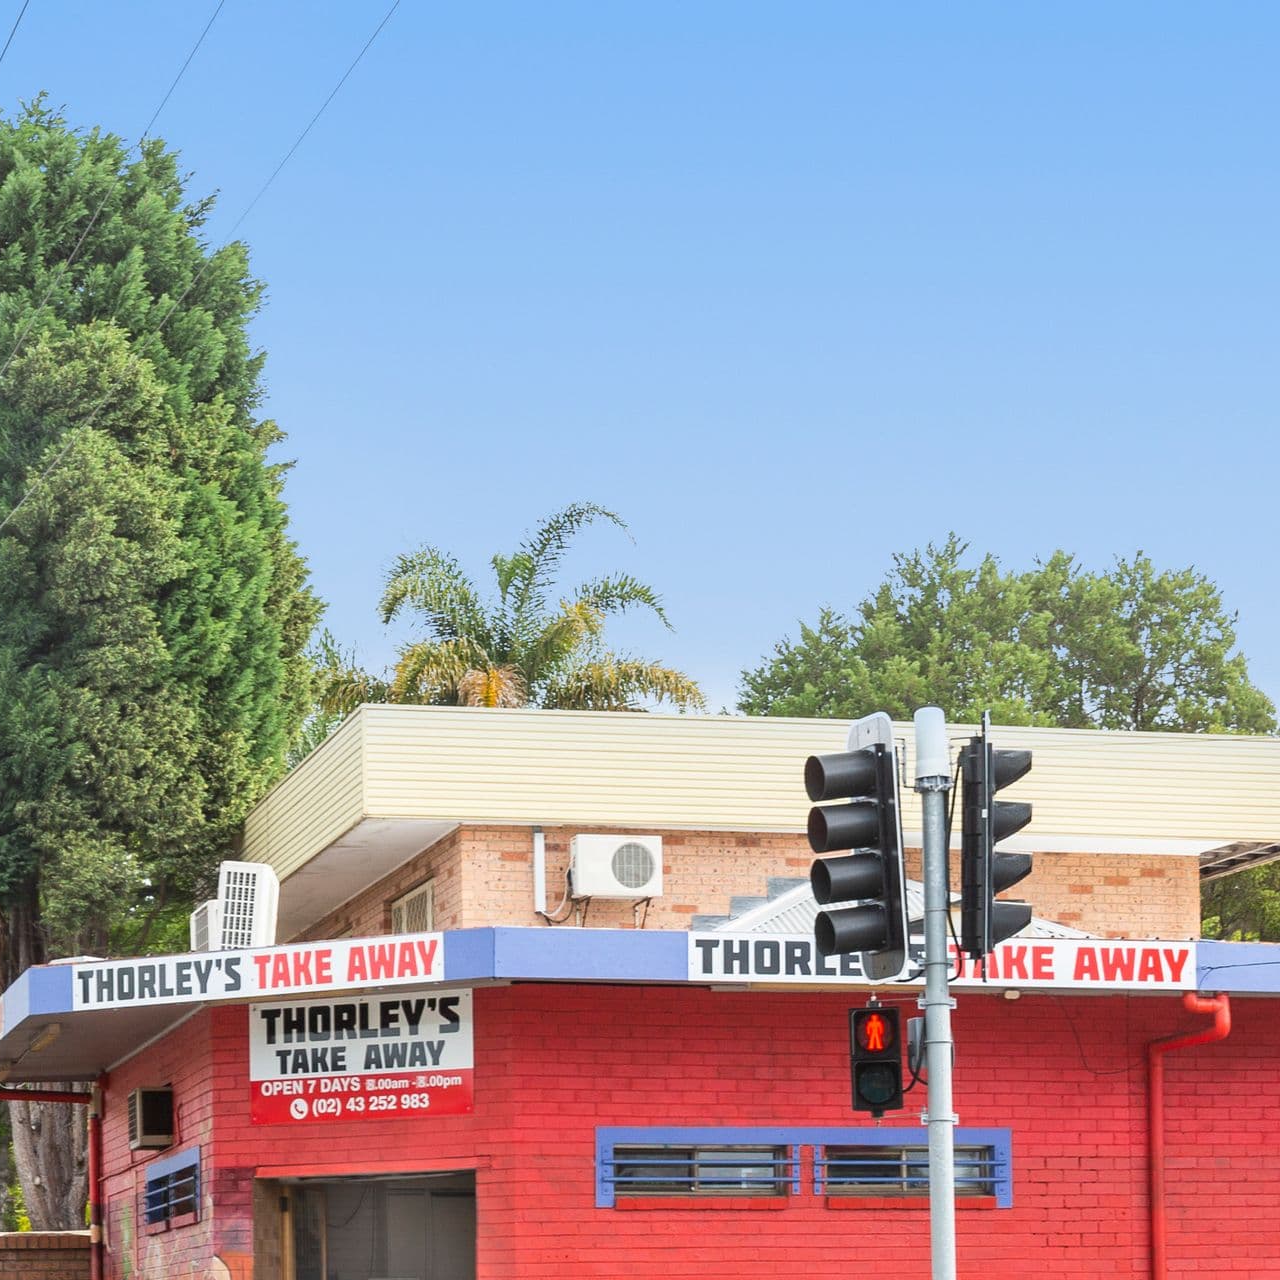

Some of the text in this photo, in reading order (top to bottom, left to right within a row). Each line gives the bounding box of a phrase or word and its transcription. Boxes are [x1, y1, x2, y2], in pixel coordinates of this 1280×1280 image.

[77, 940, 438, 1004] THORLEY'S TAKE AWAY
[1073, 947, 1189, 982] AWAY
[261, 997, 460, 1044] THORLEY'S
[276, 1040, 445, 1075] TAKE AWAY
[261, 1080, 304, 1096] OPEN
[308, 1080, 317, 1093] 7
[320, 1077, 360, 1093] DAYS
[312, 1093, 430, 1116] (02) 43 252 983
